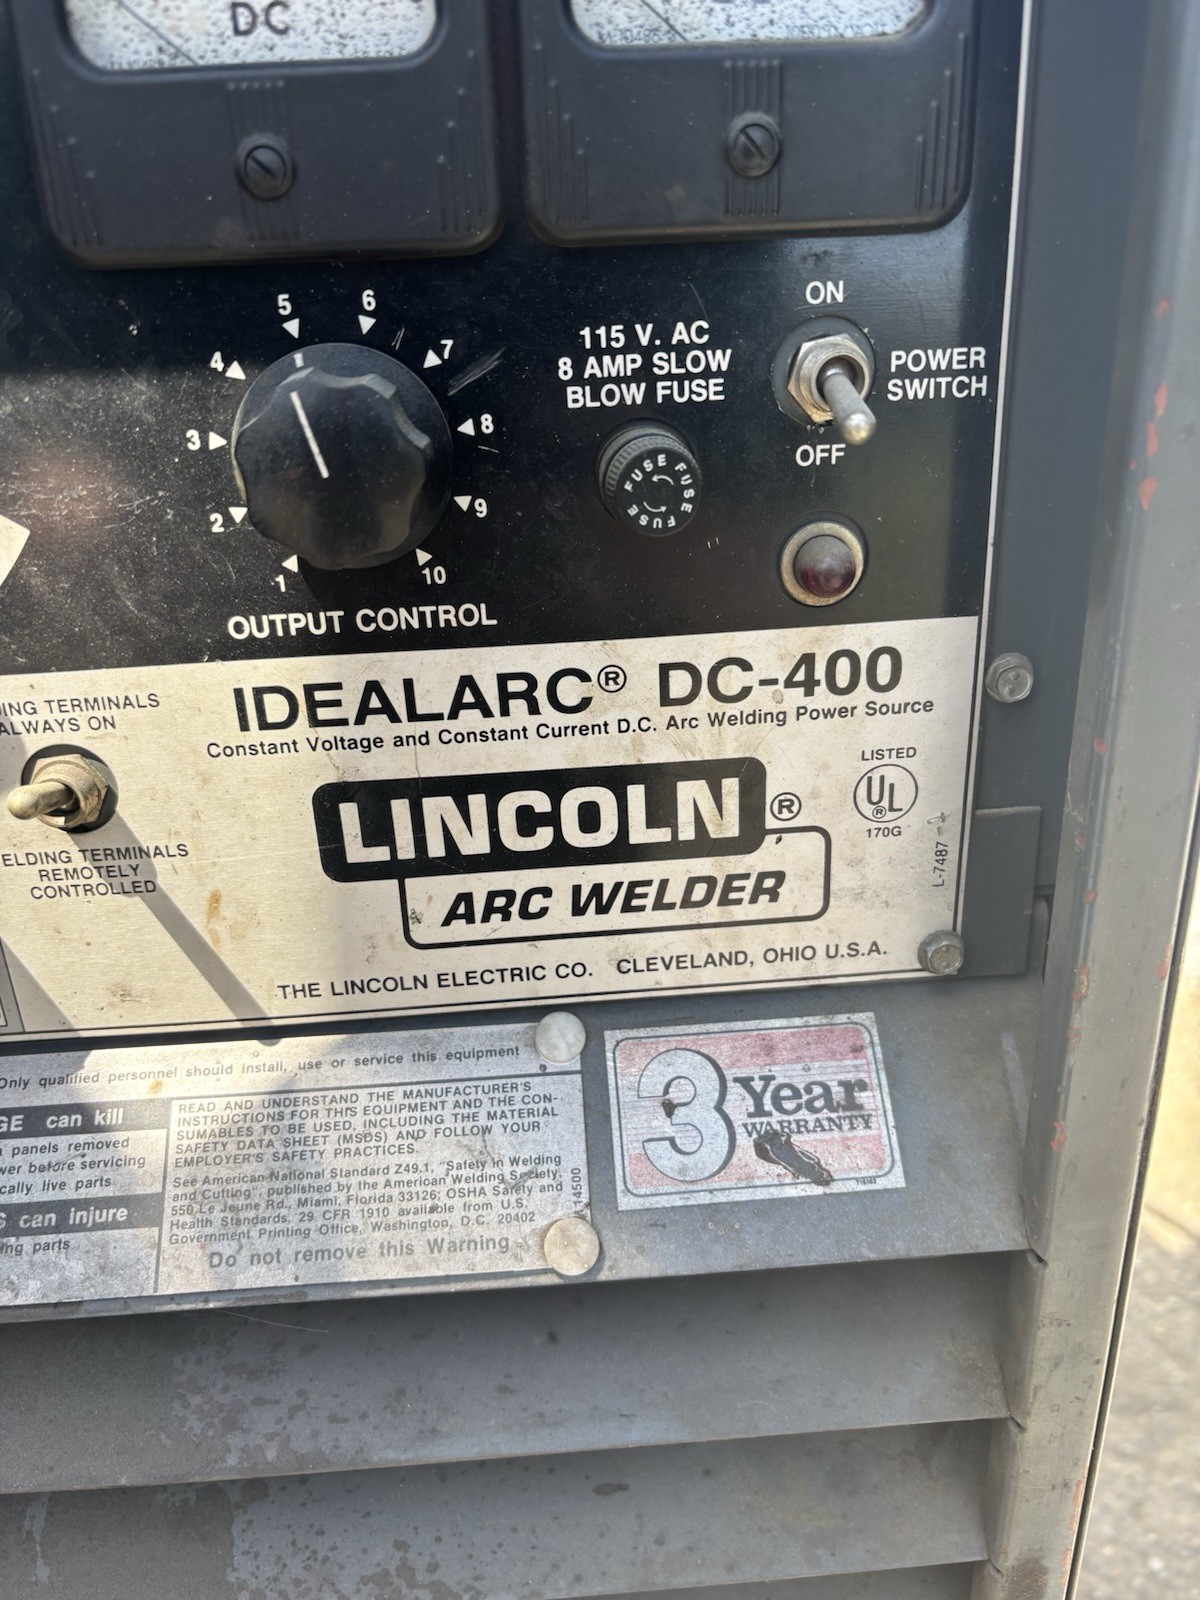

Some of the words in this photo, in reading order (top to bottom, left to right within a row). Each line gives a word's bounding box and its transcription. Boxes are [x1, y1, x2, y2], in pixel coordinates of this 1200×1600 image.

[230, 0, 290, 36] DC
[361, 289, 376, 311] 6
[805, 280, 844, 304] ON
[277, 294, 293, 316] 5
[578, 325, 626, 349] 115
[636, 323, 661, 346] V.
[671, 320, 709, 345] AC
[210, 351, 225, 373] 4
[440, 339, 454, 360] 7
[890, 347, 986, 372] POWER
[557, 357, 573, 381] 8
[583, 352, 642, 379] AMP
[652, 349, 732, 374] SLOW
[566, 382, 647, 409] BLOW
[656, 378, 725, 404] FUSE
[887, 375, 988, 401] SWITCH
[479, 414, 494, 434] 8
[186, 429, 201, 451] 3
[795, 443, 846, 468] OFF
[624, 454, 667, 492] FUSE
[674, 462, 695, 513] FUSE
[474, 498, 488, 518] 9
[627, 504, 676, 529] FUSE
[209, 513, 225, 533] 2
[275, 575, 286, 593] 1
[422, 566, 446, 585] 10
[228, 610, 345, 640] OUTPUT
[355, 603, 498, 633] CONTROL
[658, 646, 902, 708] DC-400
[44, 693, 160, 714] TERMINALS
[0, 717, 81, 736] ALWAYS
[87, 715, 117, 730] ON
[207, 738, 300, 758] Constant
[306, 735, 384, 754] Voltage
[393, 730, 430, 748] and
[438, 724, 528, 745] Constant
[536, 720, 609, 739] Current
[617, 717, 657, 733] D.C.
[666, 715, 699, 731] Arc
[707, 709, 788, 727] Welding
[796, 704, 857, 721] Power
[865, 699, 934, 717] Source
[861, 746, 917, 761] LISTED
[338, 777, 740, 865] LINCOLN
[866, 826, 902, 838] 170G
[78, 844, 189, 862] TERMINALS
[38, 864, 140, 882] REMOTELY
[30, 880, 156, 900] CONTROLLED
[441, 884, 552, 927] ARC
[571, 869, 787, 918] WELDER
[277, 982, 322, 999] THE
[331, 974, 428, 996] LINCOLN
[437, 965, 546, 988] ELECTRIC
[554, 962, 593, 979] CO.
[616, 950, 754, 974] CLEVELAND,
[763, 945, 816, 963] OHIO
[825, 941, 887, 959] U.S.A.
[38, 1072, 100, 1088] qualified
[107, 1068, 177, 1084] personnel
[186, 1064, 233, 1077] should
[242, 1062, 287, 1075] install,
[298, 1060, 322, 1070] use
[354, 1054, 403, 1067] service
[412, 1051, 437, 1063] this
[446, 1046, 520, 1061] equipment
[179, 1102, 216, 1113] READ
[224, 1100, 254, 1111] AND
[262, 1093, 359, 1109] UNDERSTAND
[367, 1091, 394, 1101] THE
[403, 1082, 532, 1100] MANUFACTURER'S
[733, 1074, 868, 1118] Year
[46, 1114, 82, 1129] can
[94, 1107, 124, 1126] kill
[177, 1111, 290, 1127] INSTRUCTIONS
[291, 1108, 319, 1120] FOR
[325, 1107, 357, 1118] THIS
[363, 1100, 448, 1115] EQUIPMENT
[453, 1098, 483, 1109] AND
[488, 1095, 515, 1107] THE
[521, 1094, 558, 1104] CON-
[637, 1047, 736, 1182] 3
[177, 1126, 254, 1141] SUMABLES
[261, 1124, 280, 1136] TO
[288, 1123, 306, 1134] BE
[314, 1121, 356, 1133] USED,
[363, 1114, 444, 1128] INCLUDING
[451, 1112, 479, 1123] THE
[487, 1106, 559, 1121] MATERIAL
[742, 1113, 873, 1138] WARRANTY
[12, 1142, 59, 1158] panels
[68, 1137, 130, 1152] removed
[176, 1141, 229, 1155] SAFETY
[237, 1138, 275, 1150] DATA
[283, 1135, 329, 1148] SHEET
[337, 1131, 388, 1145] (MSDS)
[396, 1130, 426, 1140] AND
[434, 1125, 493, 1139] FOLLOW
[501, 1121, 541, 1133] YOUR
[28, 1160, 75, 1174] before
[80, 1155, 146, 1170] servicing
[175, 1153, 264, 1167] EMPLOYER'S
[272, 1150, 326, 1163] SAFETY
[334, 1144, 418, 1158] PRACTICES.
[173, 1177, 197, 1187] See
[202, 1174, 264, 1187] American
[270, 1170, 325, 1183] National
[330, 1165, 390, 1180] Standard
[395, 1164, 434, 1175] Z49.1,
[509, 1155, 562, 1168] Welding
[42, 1179, 67, 1191] live
[75, 1176, 112, 1192] parts
[172, 1191, 196, 1202] and
[267, 1180, 332, 1197] published
[337, 1179, 353, 1193] by
[358, 1179, 378, 1190] the
[383, 1176, 447, 1189] American
[451, 1172, 505, 1185] Welding
[171, 1205, 194, 1215] 550
[220, 1201, 260, 1212] Jeune
[297, 1196, 341, 1208] Miami,
[346, 1191, 393, 1205] Florida
[446, 1186, 487, 1198] OSHA
[492, 1183, 533, 1196] Safety
[539, 1181, 563, 1192] and
[19, 1212, 56, 1228] can
[69, 1206, 129, 1227] injure
[170, 1218, 212, 1230] Health
[299, 1212, 314, 1222] 29
[322, 1210, 350, 1220] CFR
[361, 1207, 389, 1218] 1910
[398, 1203, 454, 1216] available
[463, 1201, 493, 1212] from
[501, 1200, 528, 1210] U.S.
[169, 1231, 250, 1245] Government
[258, 1227, 311, 1239] Printing
[371, 1219, 452, 1232] Washington,
[461, 1217, 490, 1227] D.C.
[497, 1212, 536, 1224] 20402
[33, 1238, 70, 1254] parts
[209, 1251, 237, 1269] Do
[250, 1249, 281, 1266] not
[294, 1246, 366, 1263] remove
[380, 1241, 415, 1257] this
[427, 1235, 510, 1254] Warning
